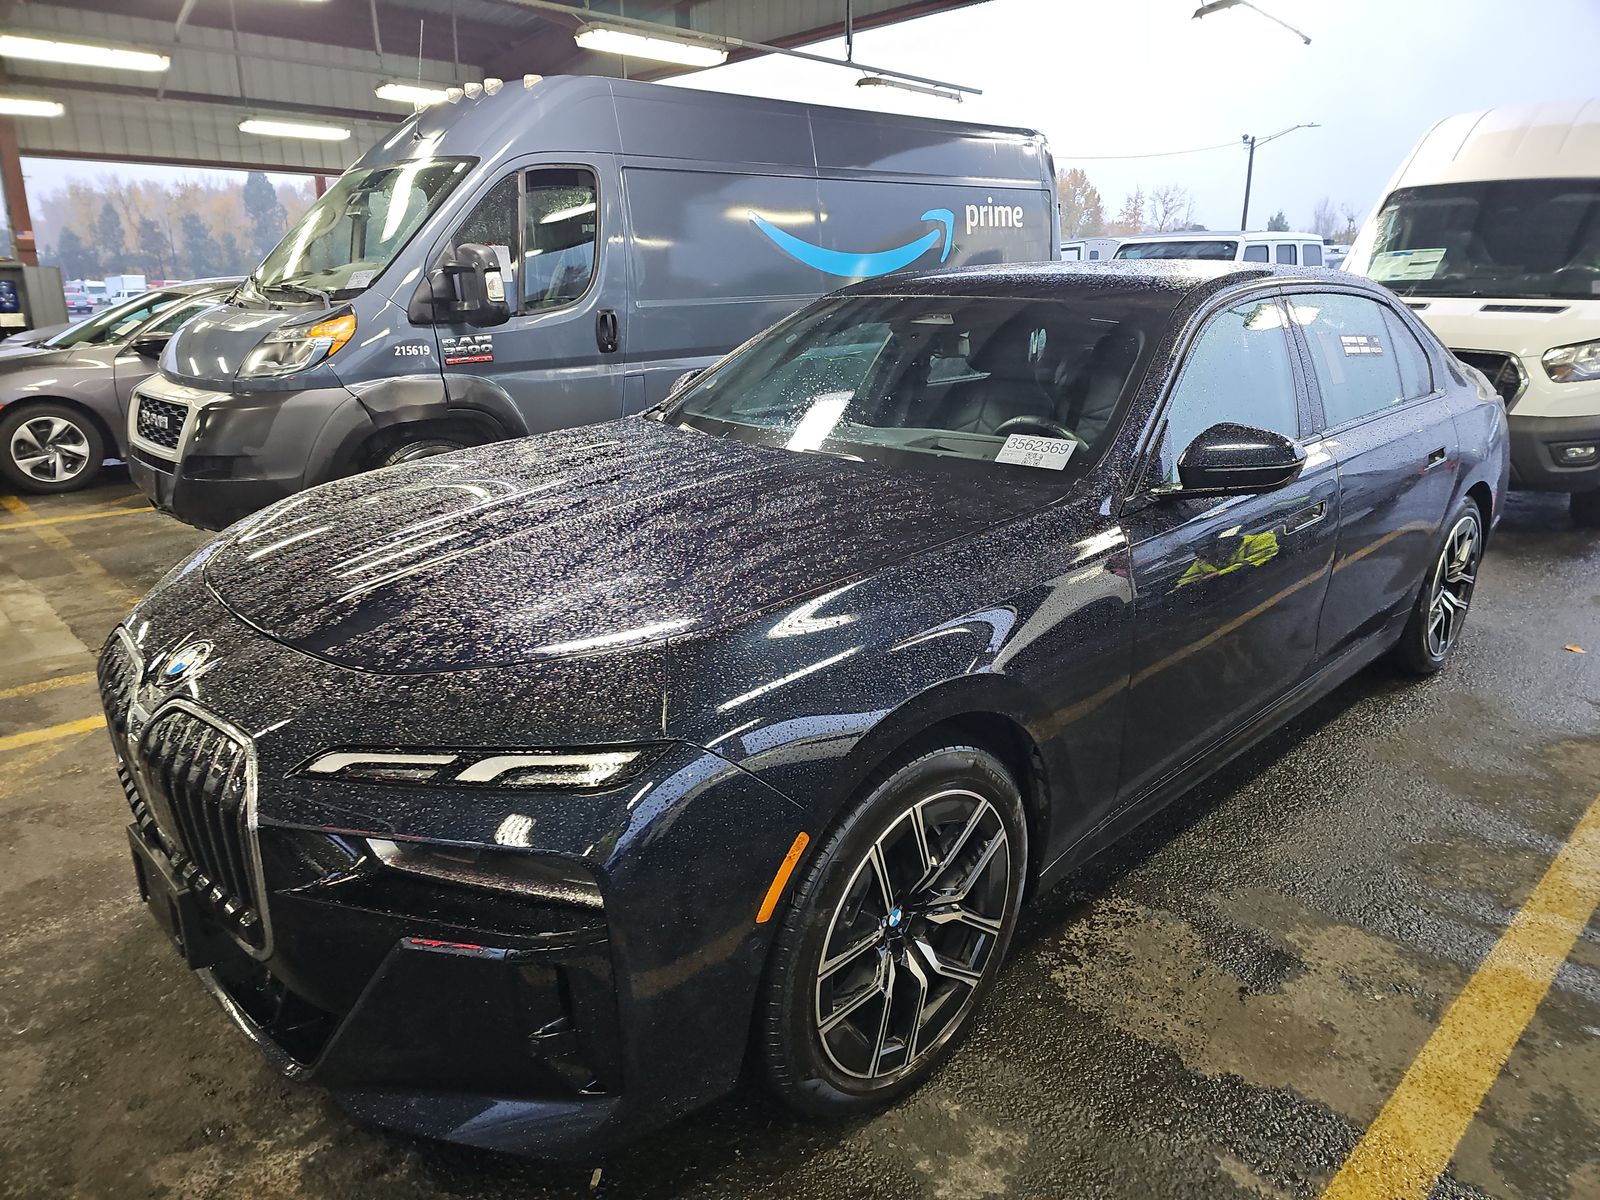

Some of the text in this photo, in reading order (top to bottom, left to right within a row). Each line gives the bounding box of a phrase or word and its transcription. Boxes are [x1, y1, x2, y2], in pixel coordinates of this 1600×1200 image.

[965, 196, 1024, 235] prime
[441, 335, 493, 347] RAM
[394, 345, 431, 356] 215619
[443, 344, 493, 355] 3500
[1007, 437, 1070, 455] 3562369
